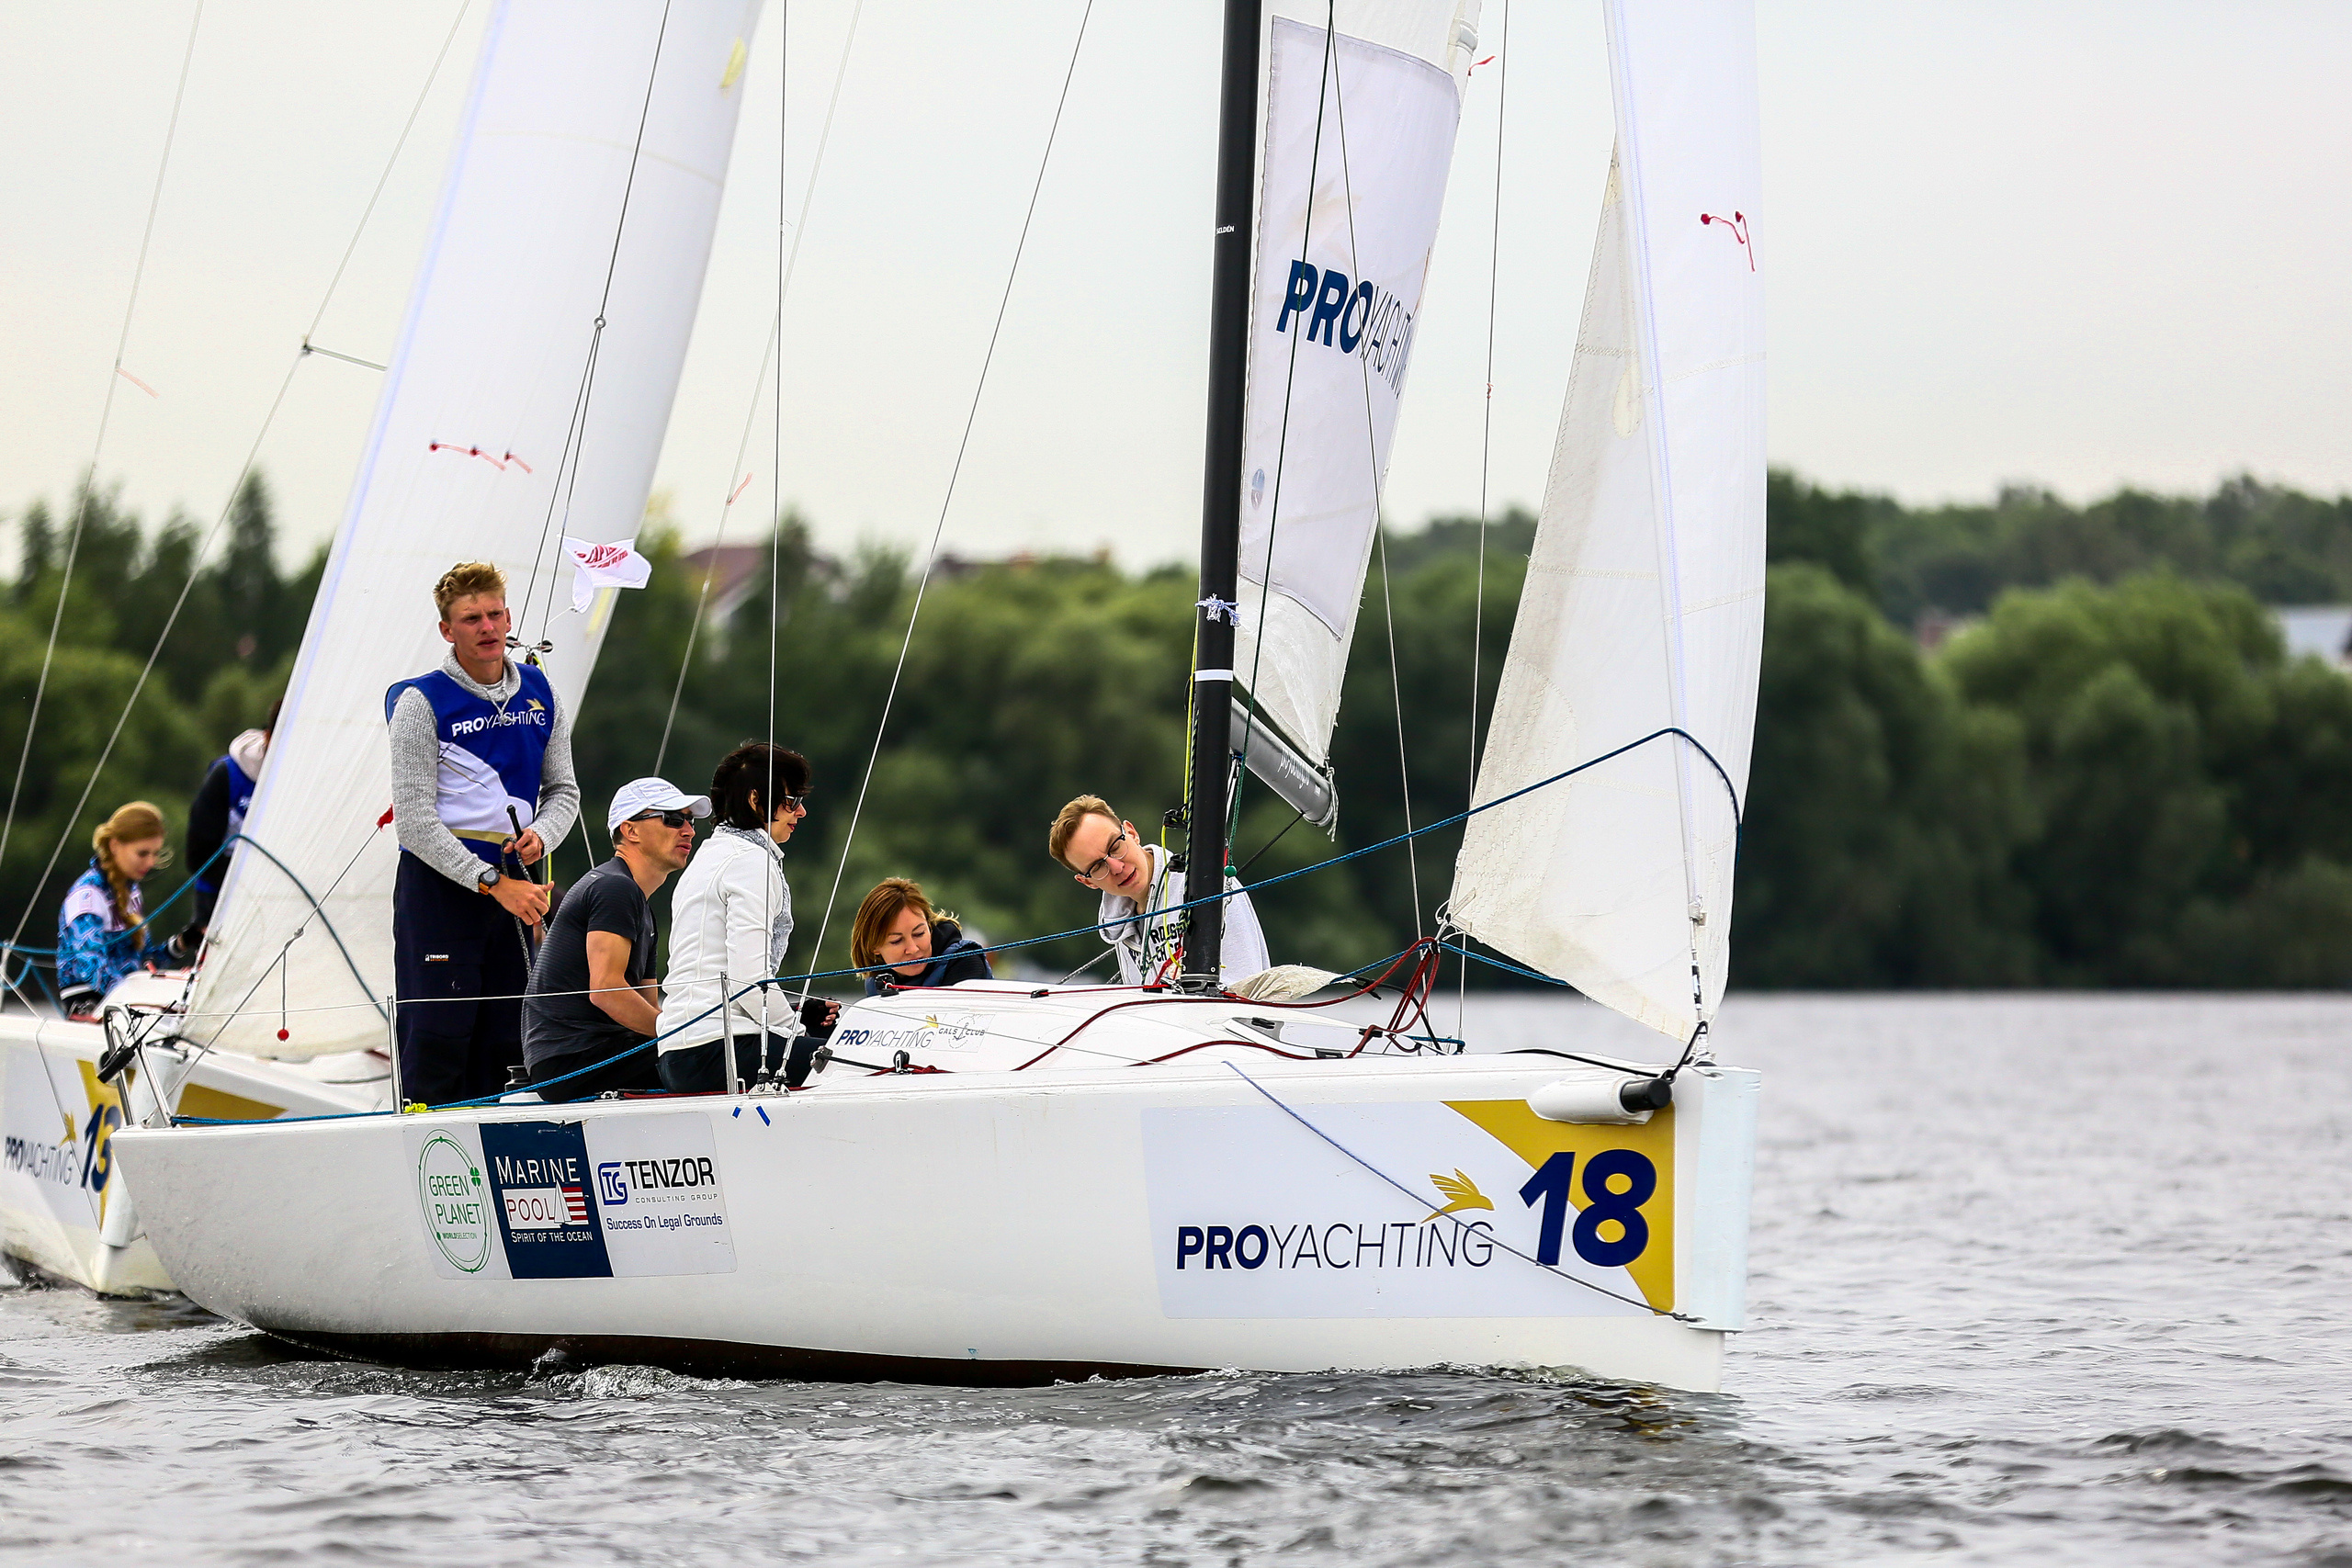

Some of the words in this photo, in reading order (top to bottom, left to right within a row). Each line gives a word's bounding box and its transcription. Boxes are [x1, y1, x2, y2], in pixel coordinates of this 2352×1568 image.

[835, 1029, 935, 1048] PROYACHTING
[938, 1027, 958, 1035] GALS
[624, 1157, 716, 1190] TENZOR
[428, 1175, 470, 1197] GREEN
[505, 1197, 556, 1222] POOL
[635, 1196, 685, 1204] CONSULTING
[1519, 1148, 1657, 1268] 18
[435, 1203, 481, 1224] PLANET
[606, 1217, 642, 1231] Success
[643, 1216, 657, 1230] On
[658, 1215, 683, 1231] Legal
[684, 1213, 723, 1227] Grounds
[537, 1232, 548, 1243] OF
[548, 1232, 566, 1242] THE
[566, 1232, 594, 1242] OCEAN
[1175, 1222, 1495, 1270] PROYACHTING
